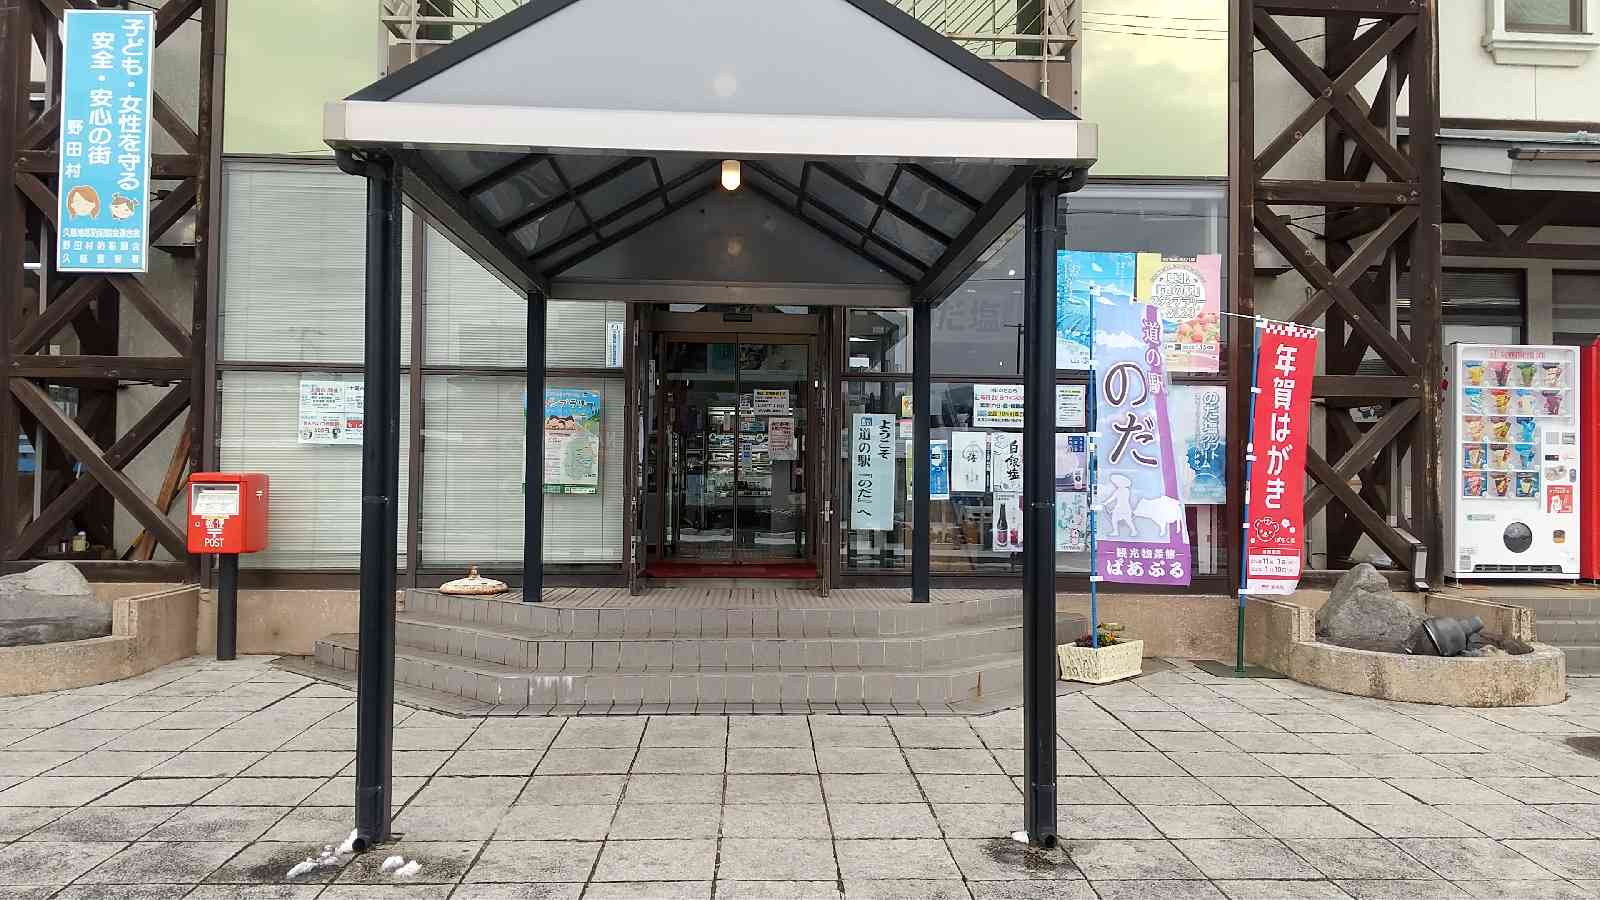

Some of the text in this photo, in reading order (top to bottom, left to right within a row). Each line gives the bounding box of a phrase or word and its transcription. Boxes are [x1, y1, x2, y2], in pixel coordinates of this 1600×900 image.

[87, 31, 115, 165] 安全・安心の街
[117, 18, 146, 191] 子ども・女性を守る
[64, 119, 83, 179] 野田村
[1142, 319, 1164, 394] 道の駅
[879, 419, 891, 460] ようこそ
[1104, 363, 1158, 467] のだ
[1264, 343, 1298, 509] 年賀はがき
[204, 538, 224, 547] POST
